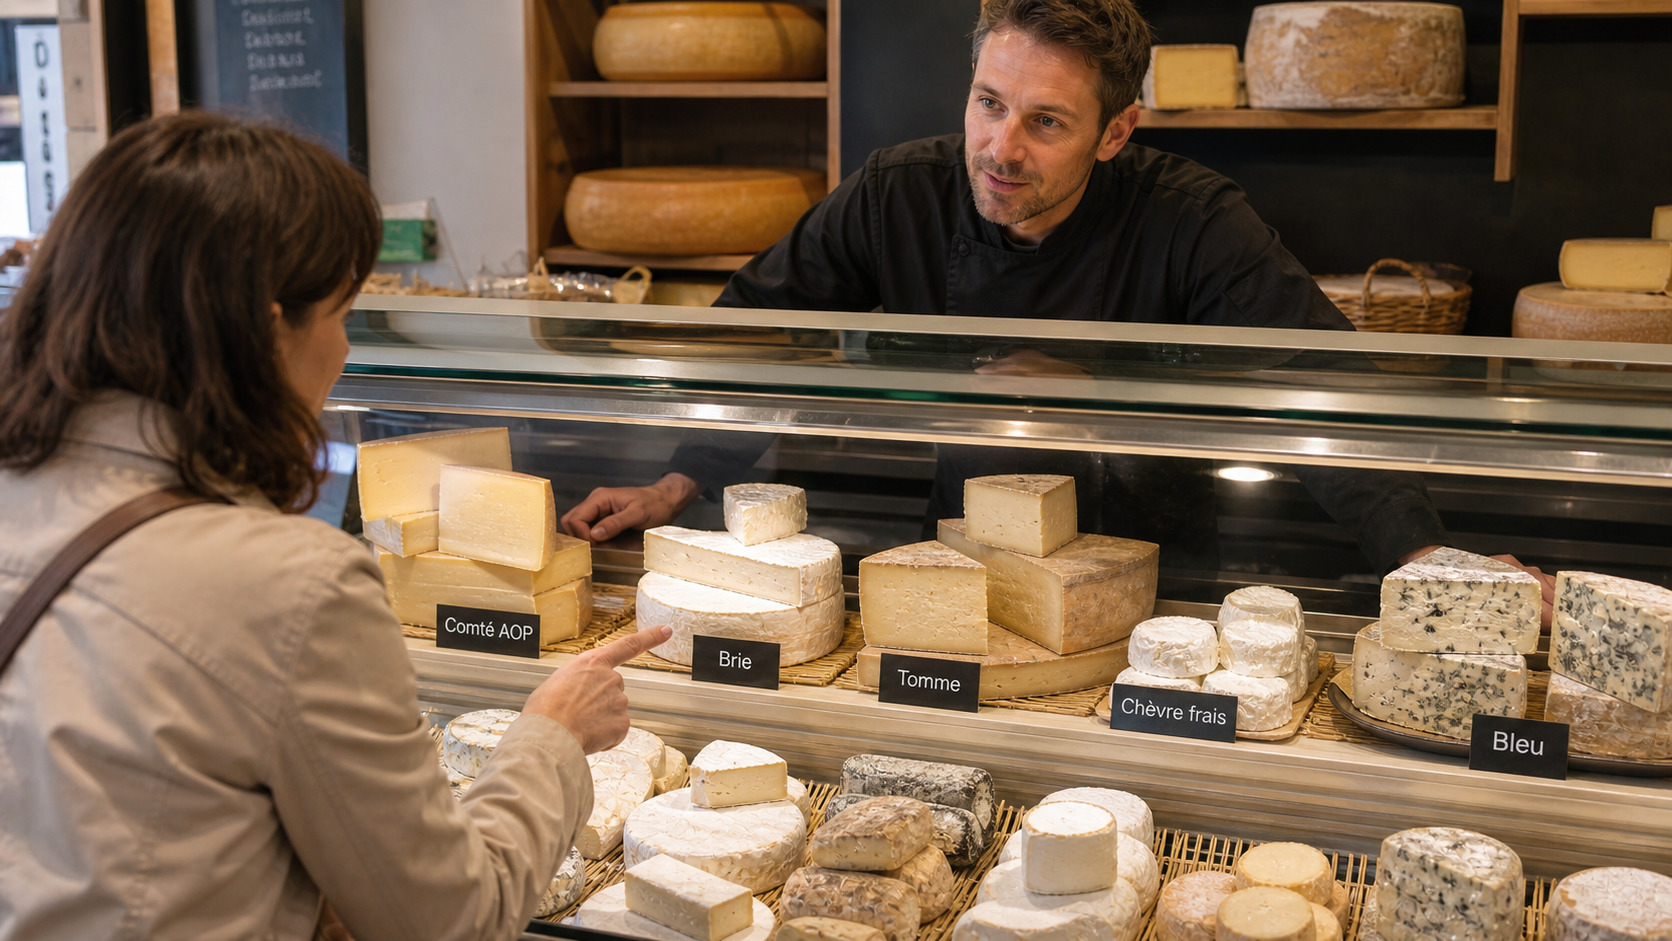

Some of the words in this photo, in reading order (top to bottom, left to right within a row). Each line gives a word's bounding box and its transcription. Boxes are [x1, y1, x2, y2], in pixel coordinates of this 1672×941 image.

[445, 617, 495, 637] Comté
[498, 623, 534, 641] AOP
[719, 650, 752, 670] Brie
[897, 669, 961, 692] Tomme
[1121, 698, 1184, 720] Chèvre
[1188, 705, 1227, 725] frais
[1493, 730, 1544, 756] Bleu
